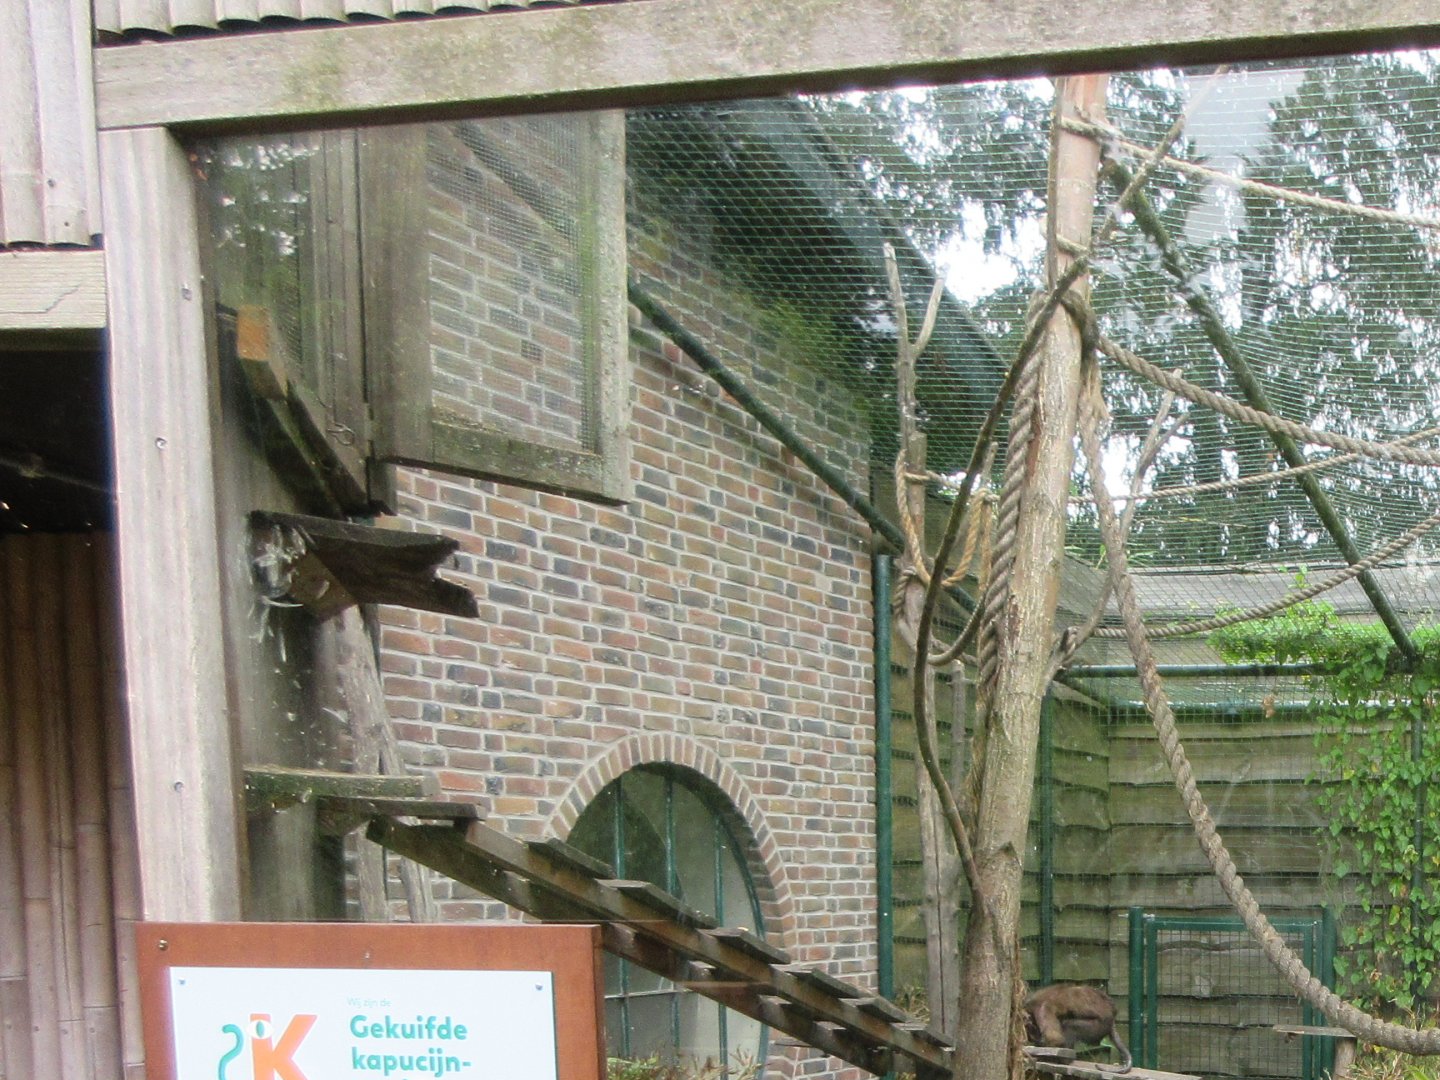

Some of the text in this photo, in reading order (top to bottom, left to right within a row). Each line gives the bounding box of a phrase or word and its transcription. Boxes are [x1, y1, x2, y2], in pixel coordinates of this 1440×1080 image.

[380, 998, 391, 1007] de
[350, 1014, 469, 1040] Gekuifde
[351, 1046, 472, 1078] kapucijn-
